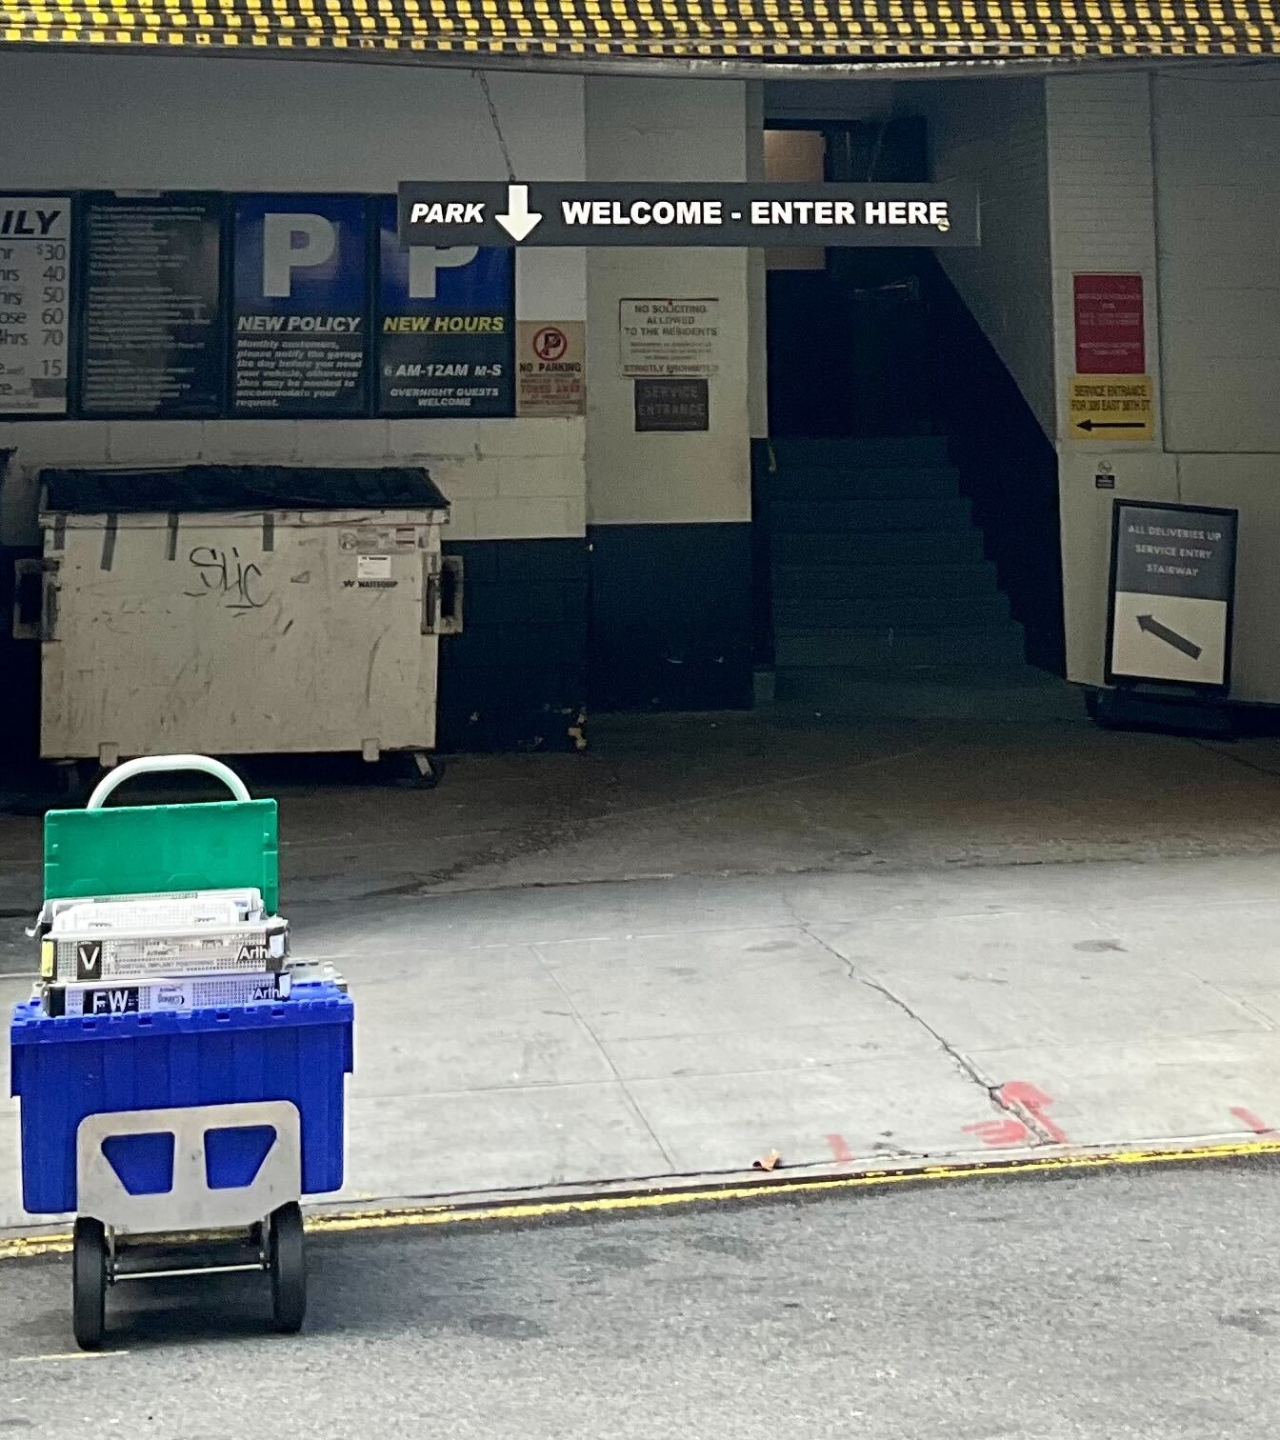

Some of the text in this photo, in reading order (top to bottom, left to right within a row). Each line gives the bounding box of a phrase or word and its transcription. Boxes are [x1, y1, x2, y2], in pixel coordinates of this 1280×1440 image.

[411, 203, 485, 223] PARK
[562, 201, 722, 225] WELCOME
[751, 201, 856, 225] ENTER
[865, 201, 949, 225] HERE
[263, 213, 336, 297] P
[43, 265, 65, 282] 40
[43, 287, 64, 303] 50
[634, 304, 707, 313] NO SOLICITING
[41, 309, 64, 325] 60
[237, 316, 361, 332] NEW POLICY
[383, 316, 504, 332] NEW HOURS
[41, 329, 63, 346] 70
[43, 360, 62, 377] 15
[395, 364, 469, 376] AM-12AM
[519, 361, 582, 373] NO PARKING
[390, 387, 499, 397] OVERNIGHT GUESTS
[418, 397, 471, 407] WELCOME
[1148, 526, 1206, 541] DELIVERIES
[1134, 544, 1177, 557] SERVICE
[1146, 563, 1199, 577] STAIRWAY
[79, 946, 100, 971] V
[238, 945, 271, 961] Arth
[93, 989, 129, 1014] FW
[253, 987, 282, 1000] Arth
